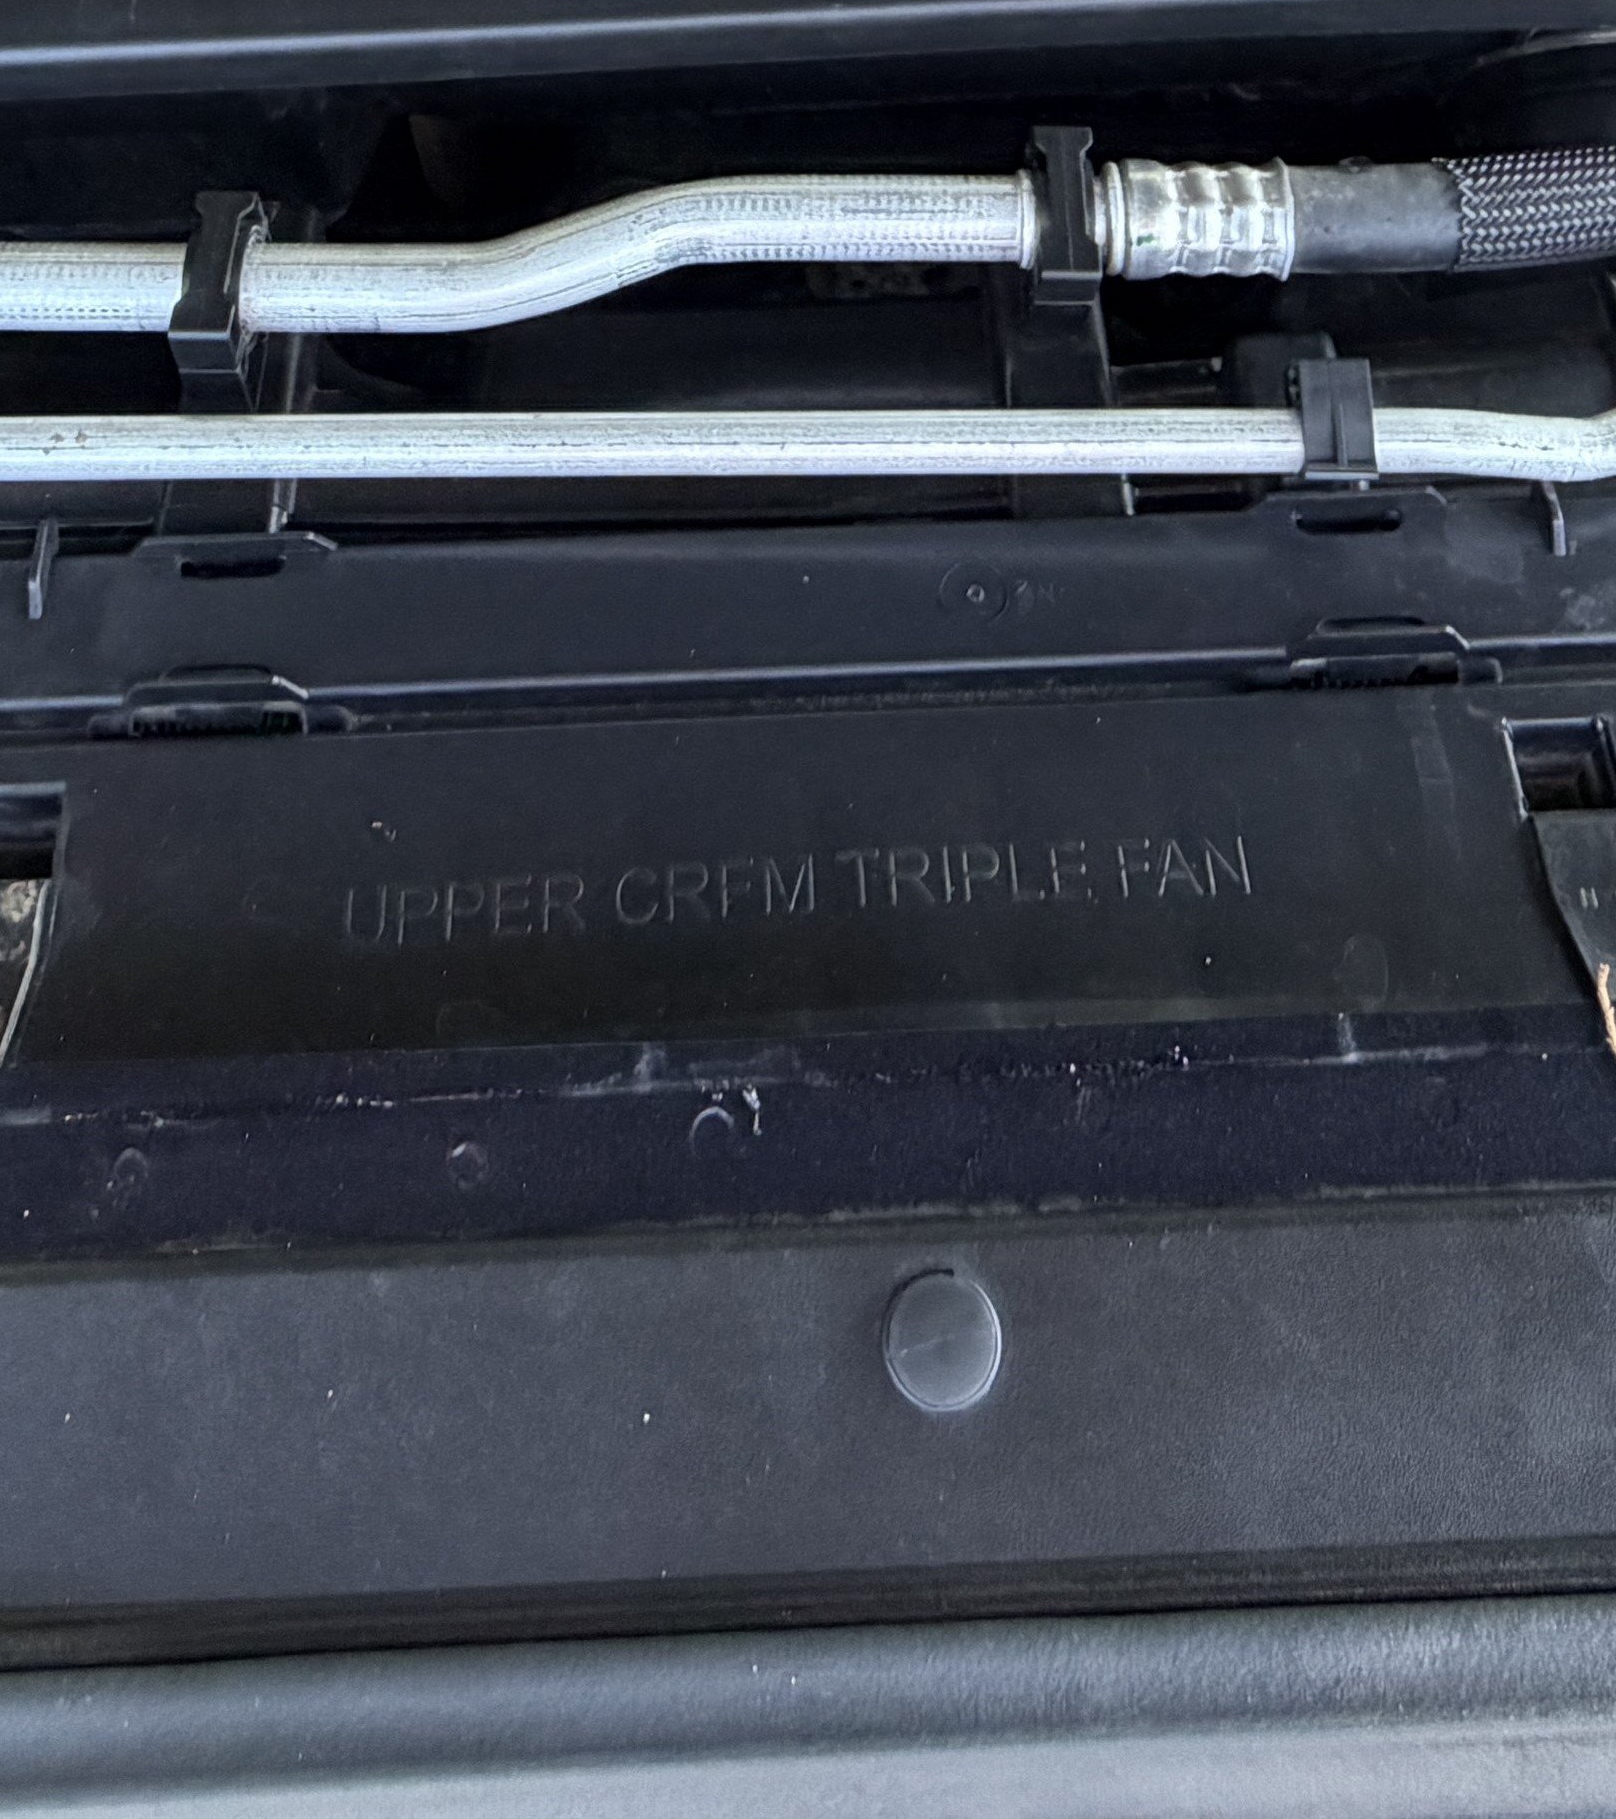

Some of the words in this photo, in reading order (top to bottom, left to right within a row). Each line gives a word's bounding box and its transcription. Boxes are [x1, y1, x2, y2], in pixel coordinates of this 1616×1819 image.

[340, 869, 586, 948] UPPER
[613, 852, 816, 929] CRFM
[833, 840, 1089, 910] TRIPLE
[1115, 835, 1255, 899] FAN
